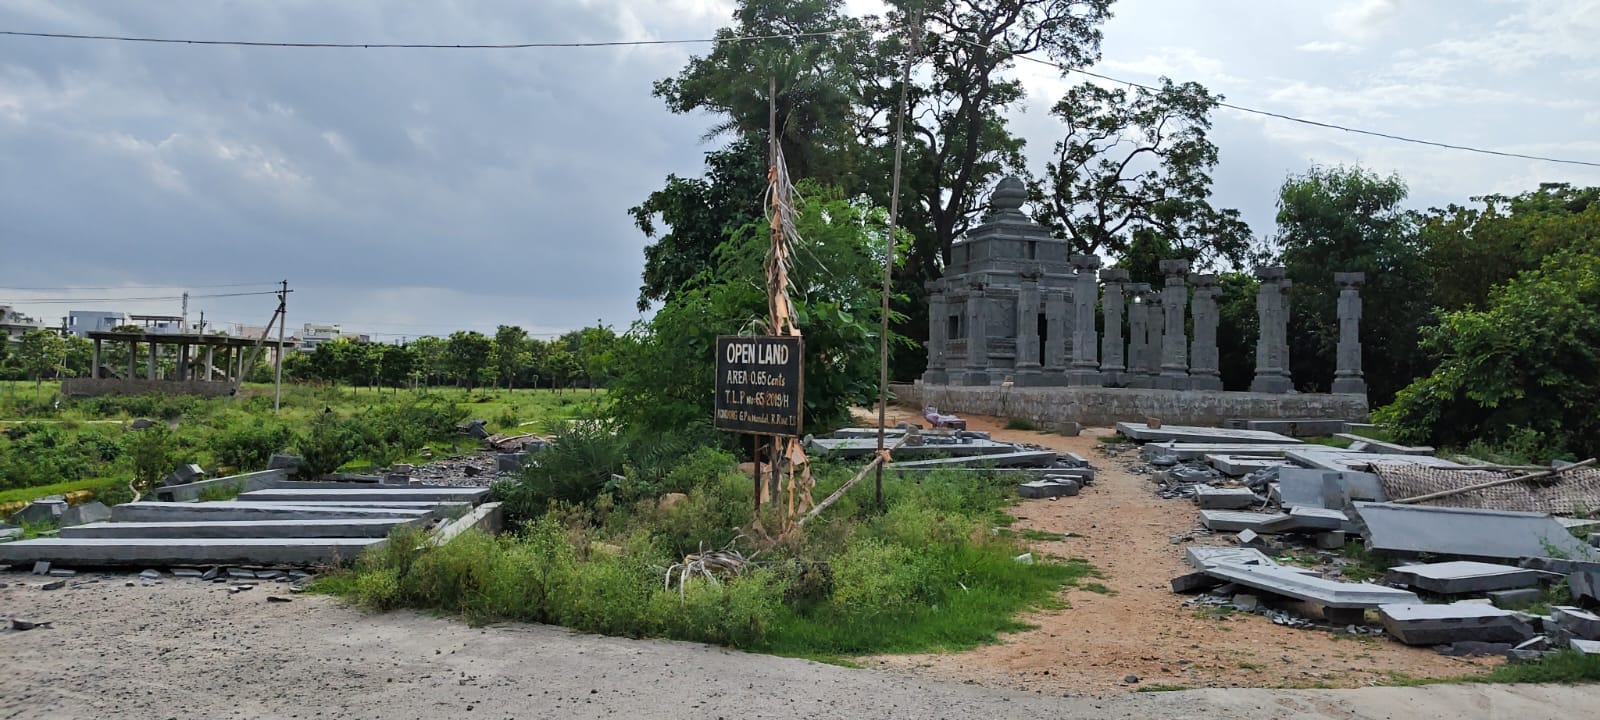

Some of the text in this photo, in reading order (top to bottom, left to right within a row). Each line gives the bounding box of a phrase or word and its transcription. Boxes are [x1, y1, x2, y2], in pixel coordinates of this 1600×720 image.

[726, 342, 789, 365] OPEN LAND
[726, 370, 786, 387] AREA 0.65 Cents
